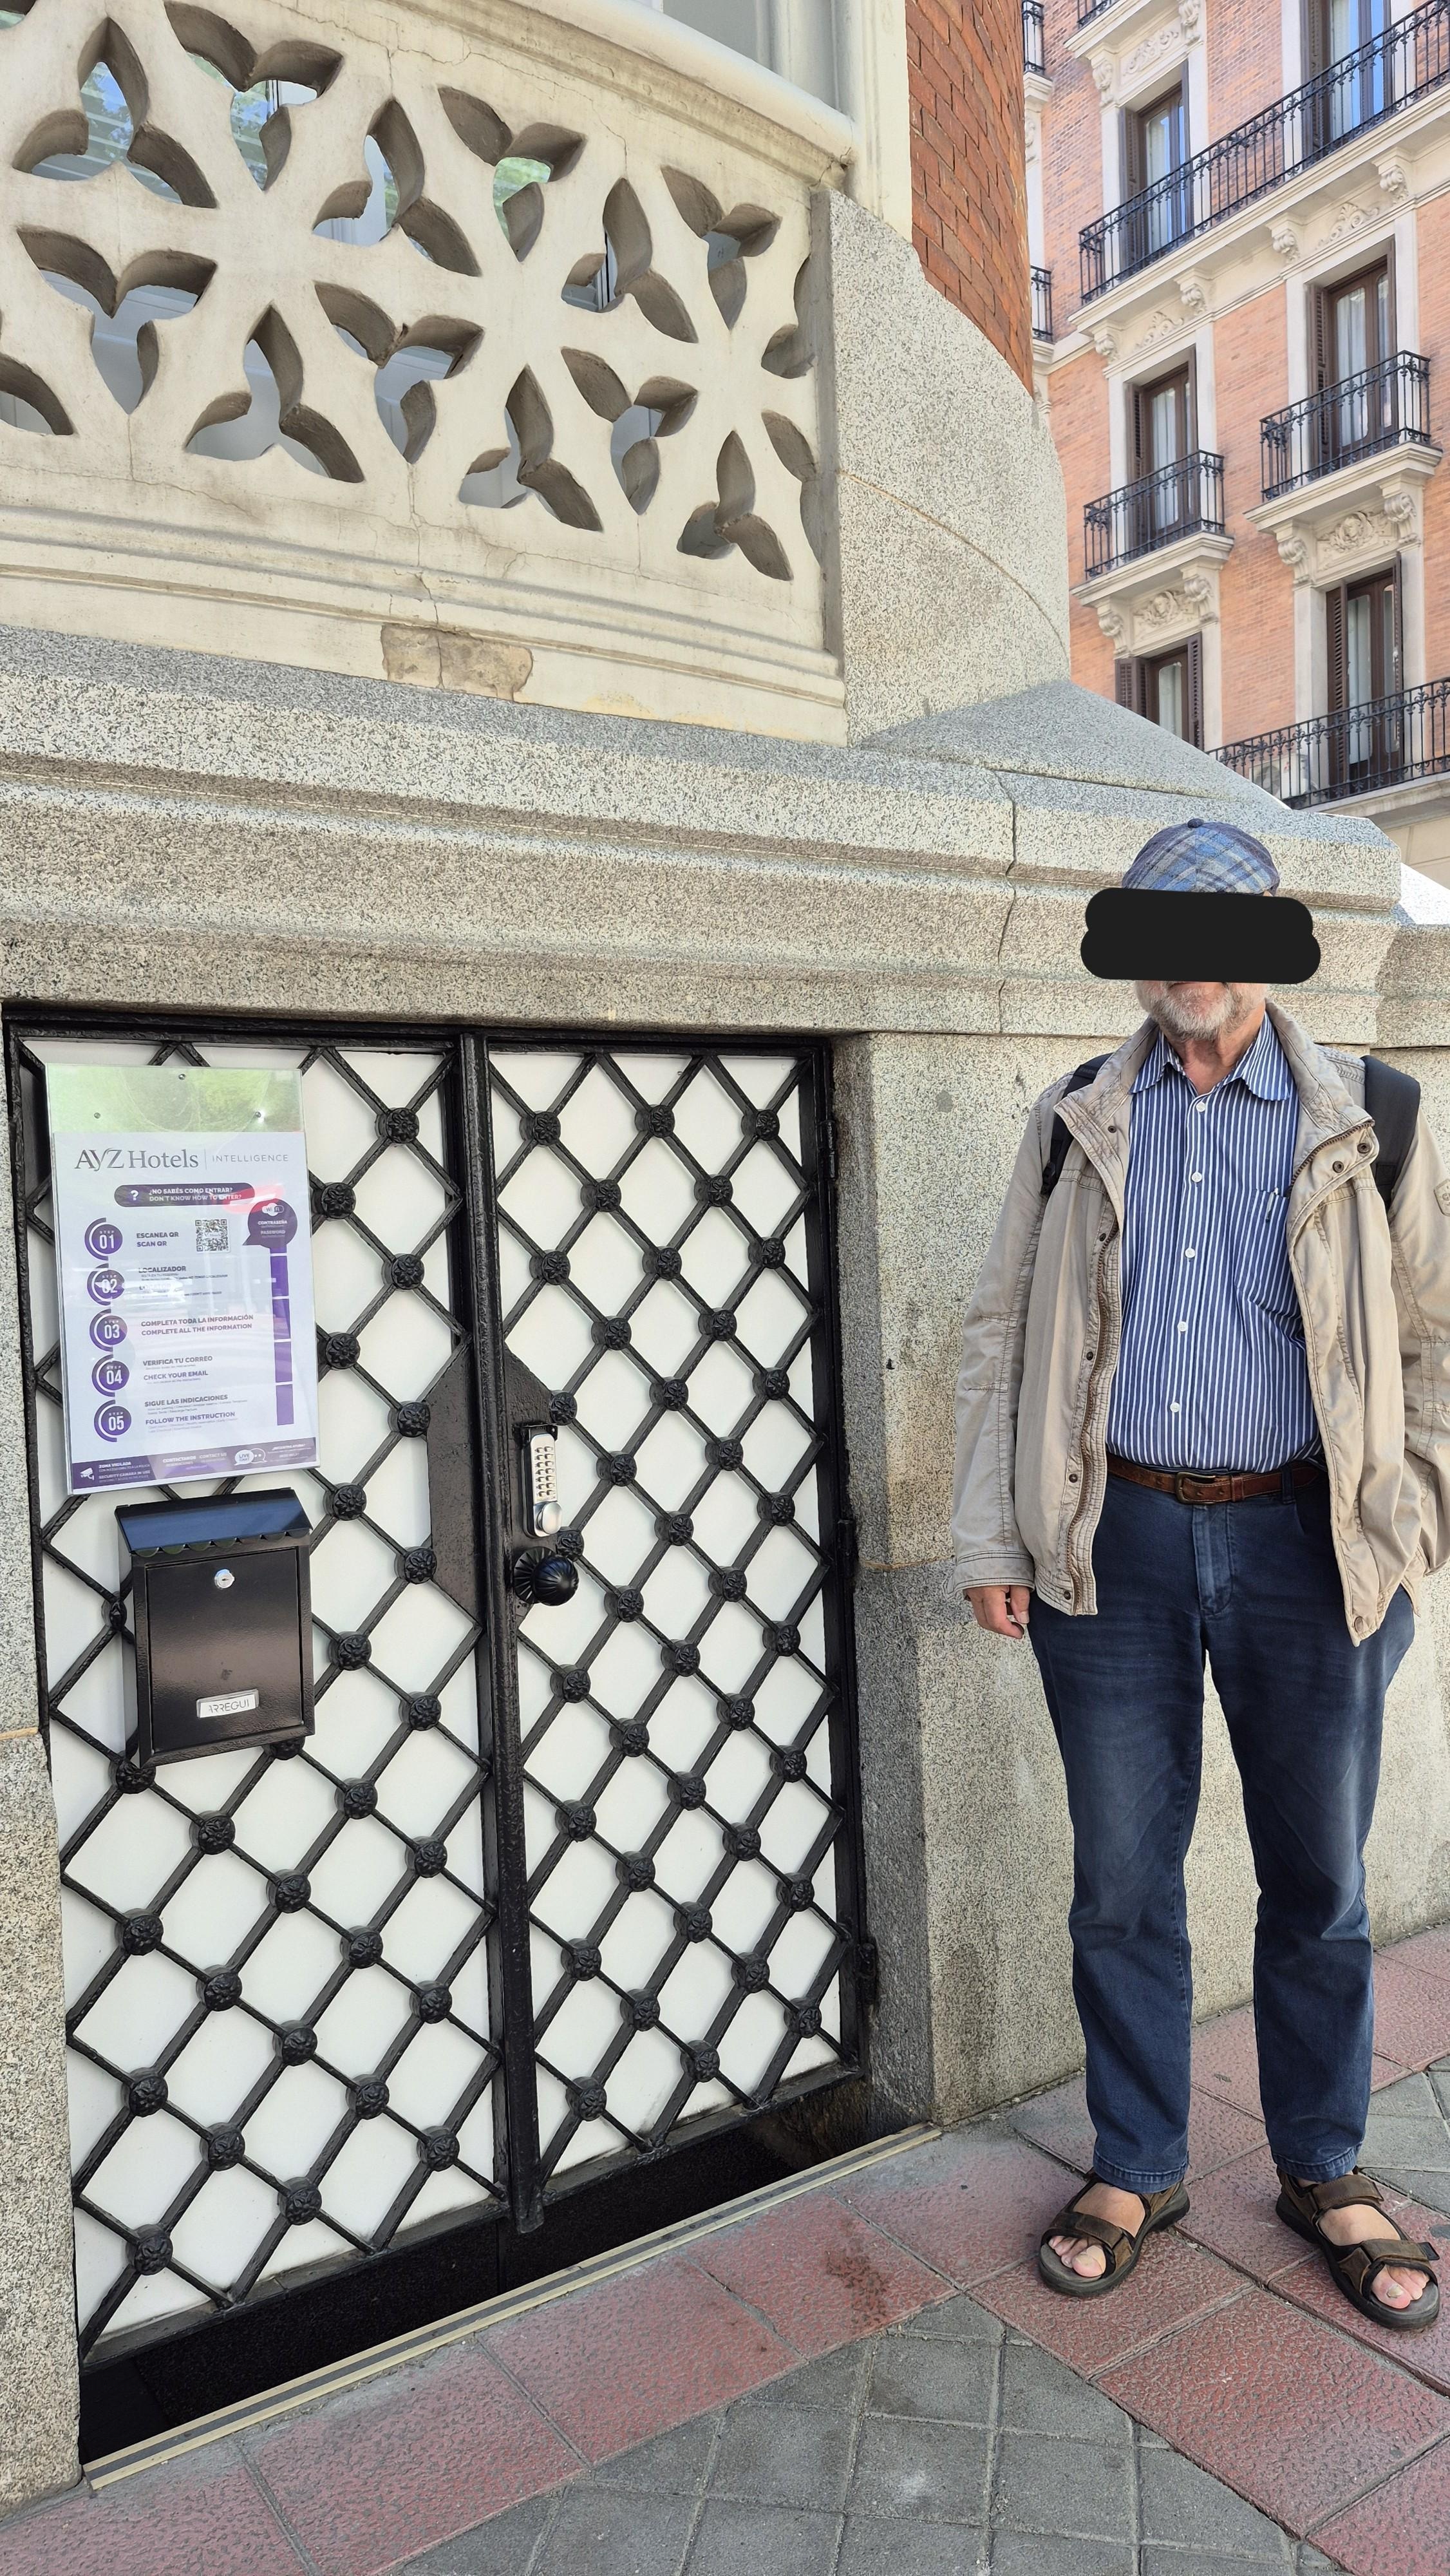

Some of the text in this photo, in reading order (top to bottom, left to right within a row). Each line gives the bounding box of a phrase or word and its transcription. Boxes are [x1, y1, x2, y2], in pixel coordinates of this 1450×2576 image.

[127, 1149, 199, 1168] Hotels
[212, 1154, 289, 1162] INTELLIGENCE
[99, 1234, 115, 1249] 01
[102, 1278, 118, 1294] 02
[207, 1314, 254, 1323] INFORMACIÓN
[104, 1323, 120, 1339] 03
[207, 1323, 252, 1332] INFORMATION
[106, 1369, 123, 1385] 04
[180, 1394, 229, 1404] INDICACIONES
[190, 1411, 236, 1421] INSTRUCTION
[108, 1416, 124, 1431] 05
[209, 1699, 250, 1713] ARREGUI
